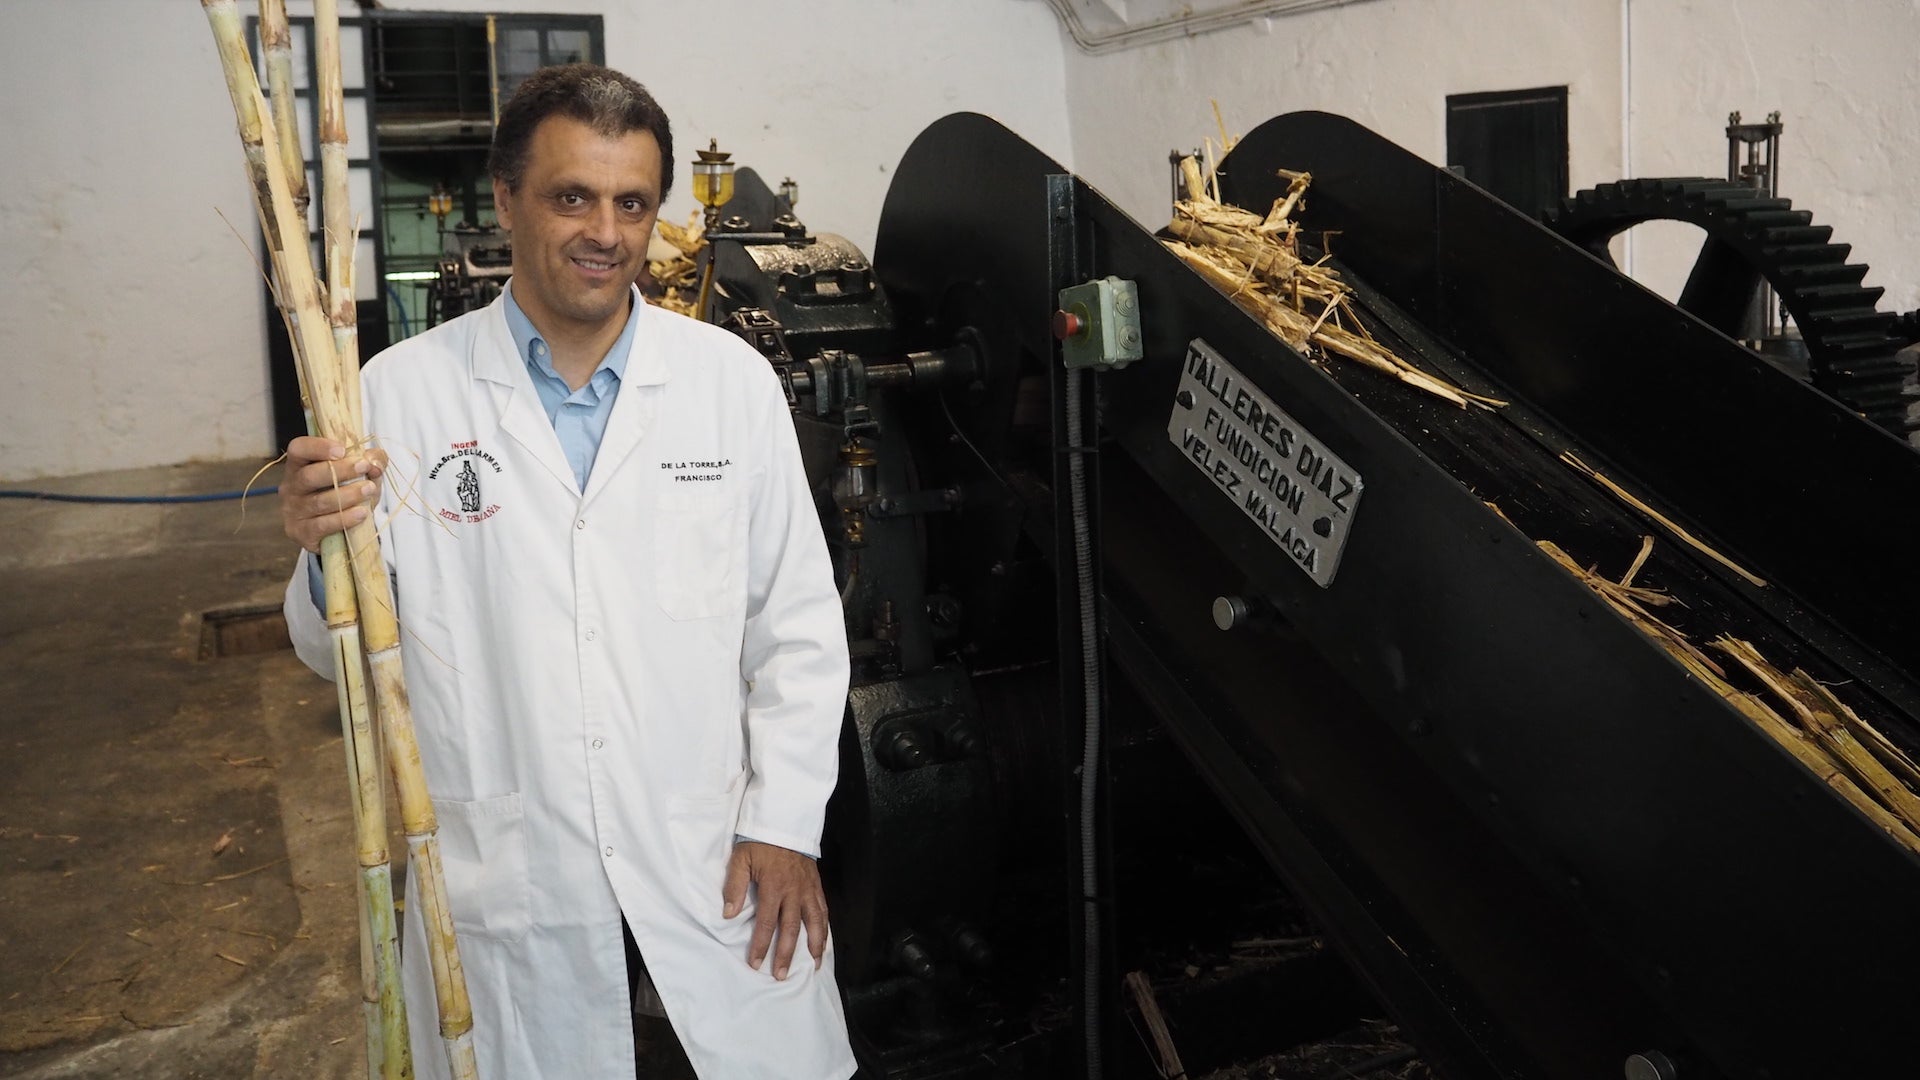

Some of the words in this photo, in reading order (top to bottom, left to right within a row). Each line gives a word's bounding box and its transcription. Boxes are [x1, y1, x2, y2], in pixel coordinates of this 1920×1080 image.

[475, 449, 502, 473] ARMEN
[1186, 347, 1296, 459] TALLERES
[1296, 443, 1355, 513] DIAZ
[1203, 407, 1307, 516] FUNDICION
[674, 474, 722, 482] FRANCISCO
[1181, 427, 1244, 498] VELEZ
[1245, 489, 1319, 574] MALAGA
[439, 508, 462, 522] MIEL
